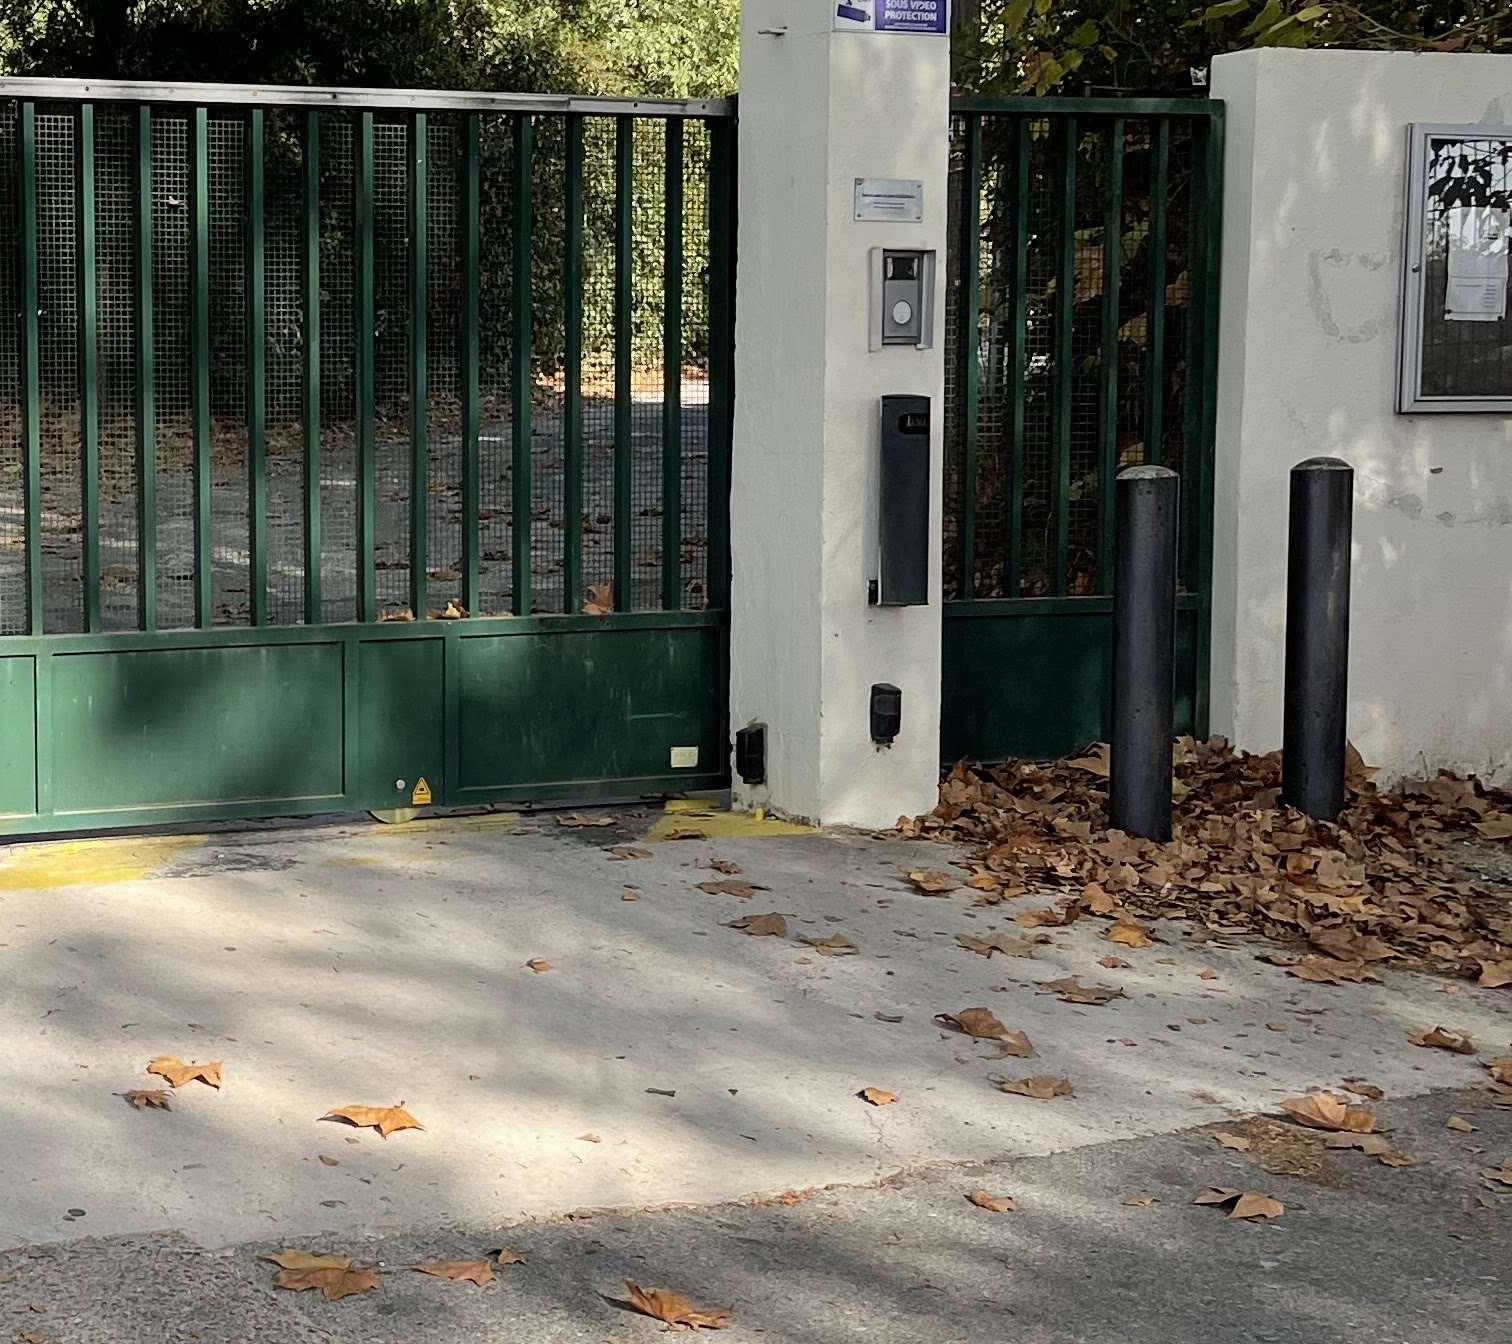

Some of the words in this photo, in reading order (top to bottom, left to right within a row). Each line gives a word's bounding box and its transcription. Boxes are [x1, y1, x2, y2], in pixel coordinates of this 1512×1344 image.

[885, 0, 908, 9] SOUS
[910, 0, 937, 10] VIDEO
[884, 10, 937, 21] PROTECTION
